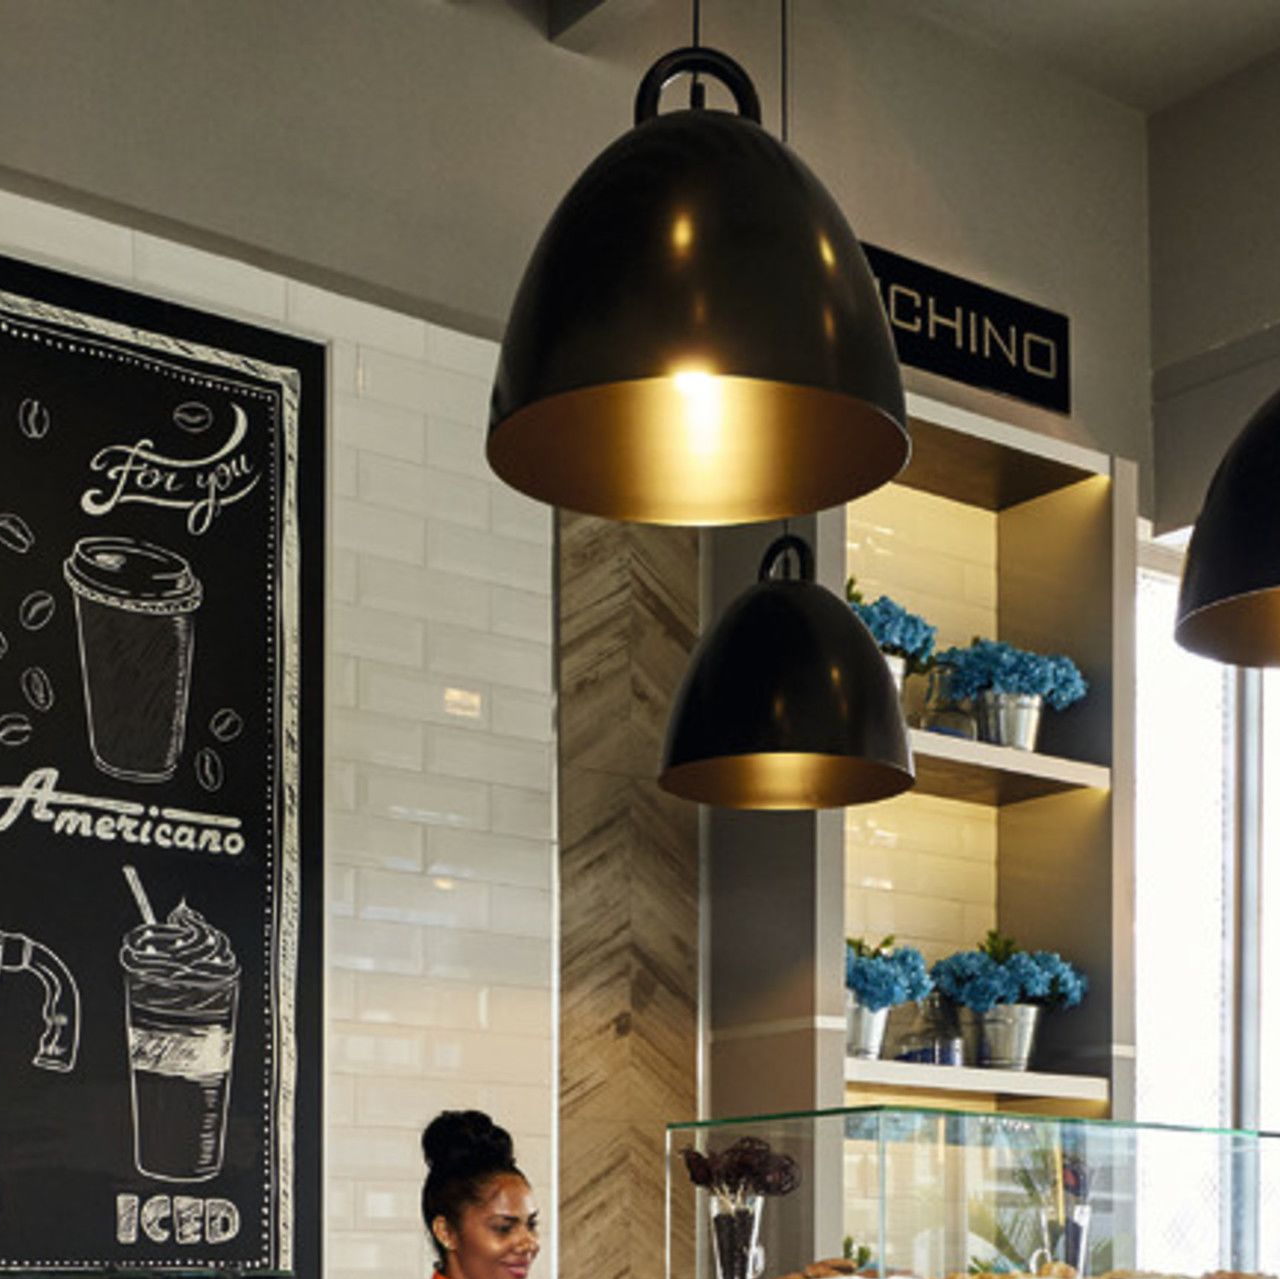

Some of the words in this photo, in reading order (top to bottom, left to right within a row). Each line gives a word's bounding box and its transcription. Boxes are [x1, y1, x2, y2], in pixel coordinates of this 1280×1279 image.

[873, 277, 1058, 380] CHINO
[80, 438, 184, 516] For
[187, 453, 255, 536] you
[116, 1194, 242, 1245] ICED
